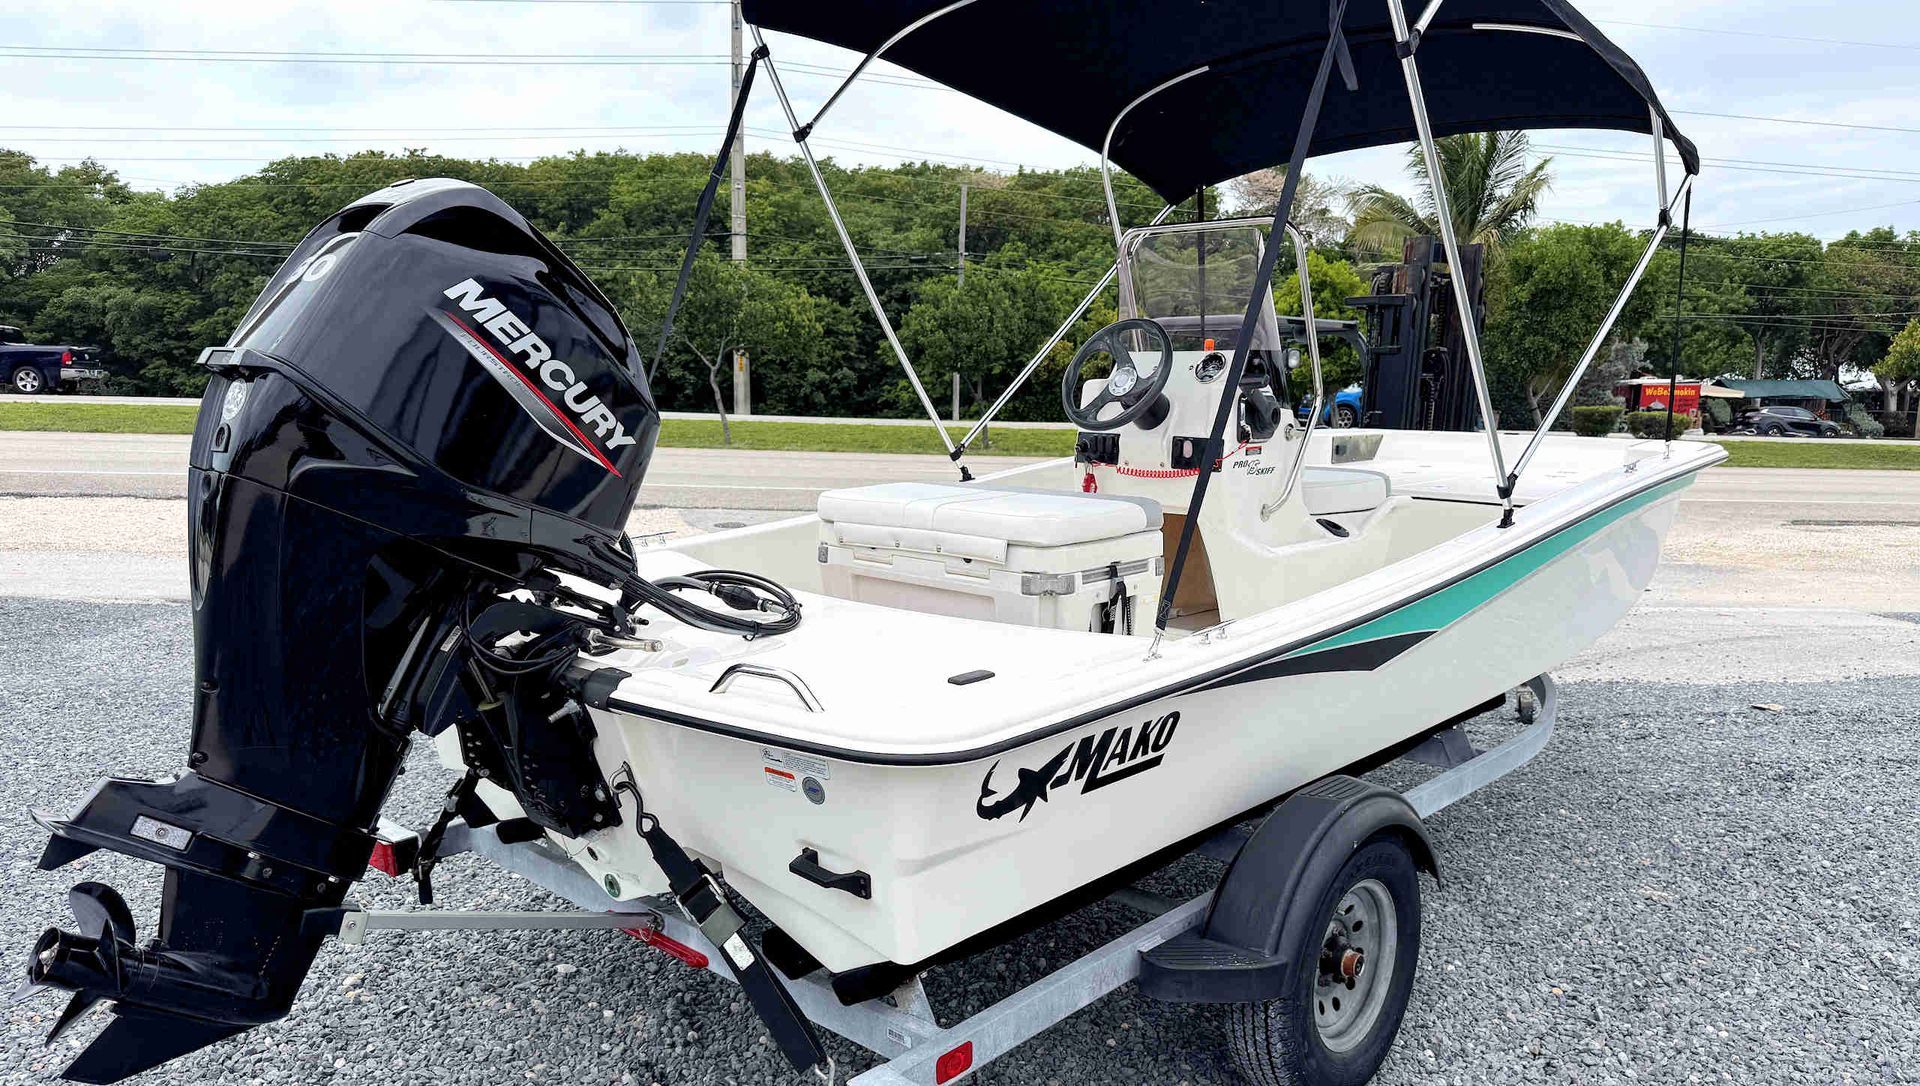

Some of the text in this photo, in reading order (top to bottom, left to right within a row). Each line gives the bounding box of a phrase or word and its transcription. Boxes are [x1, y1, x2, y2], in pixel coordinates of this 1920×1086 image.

[443, 278, 636, 450] MERCURY
[1645, 386, 1696, 396] WeBemokin
[1233, 460, 1248, 469] PRO
[1255, 466, 1276, 475] SKIFF
[1050, 711, 1180, 795] MAKO
